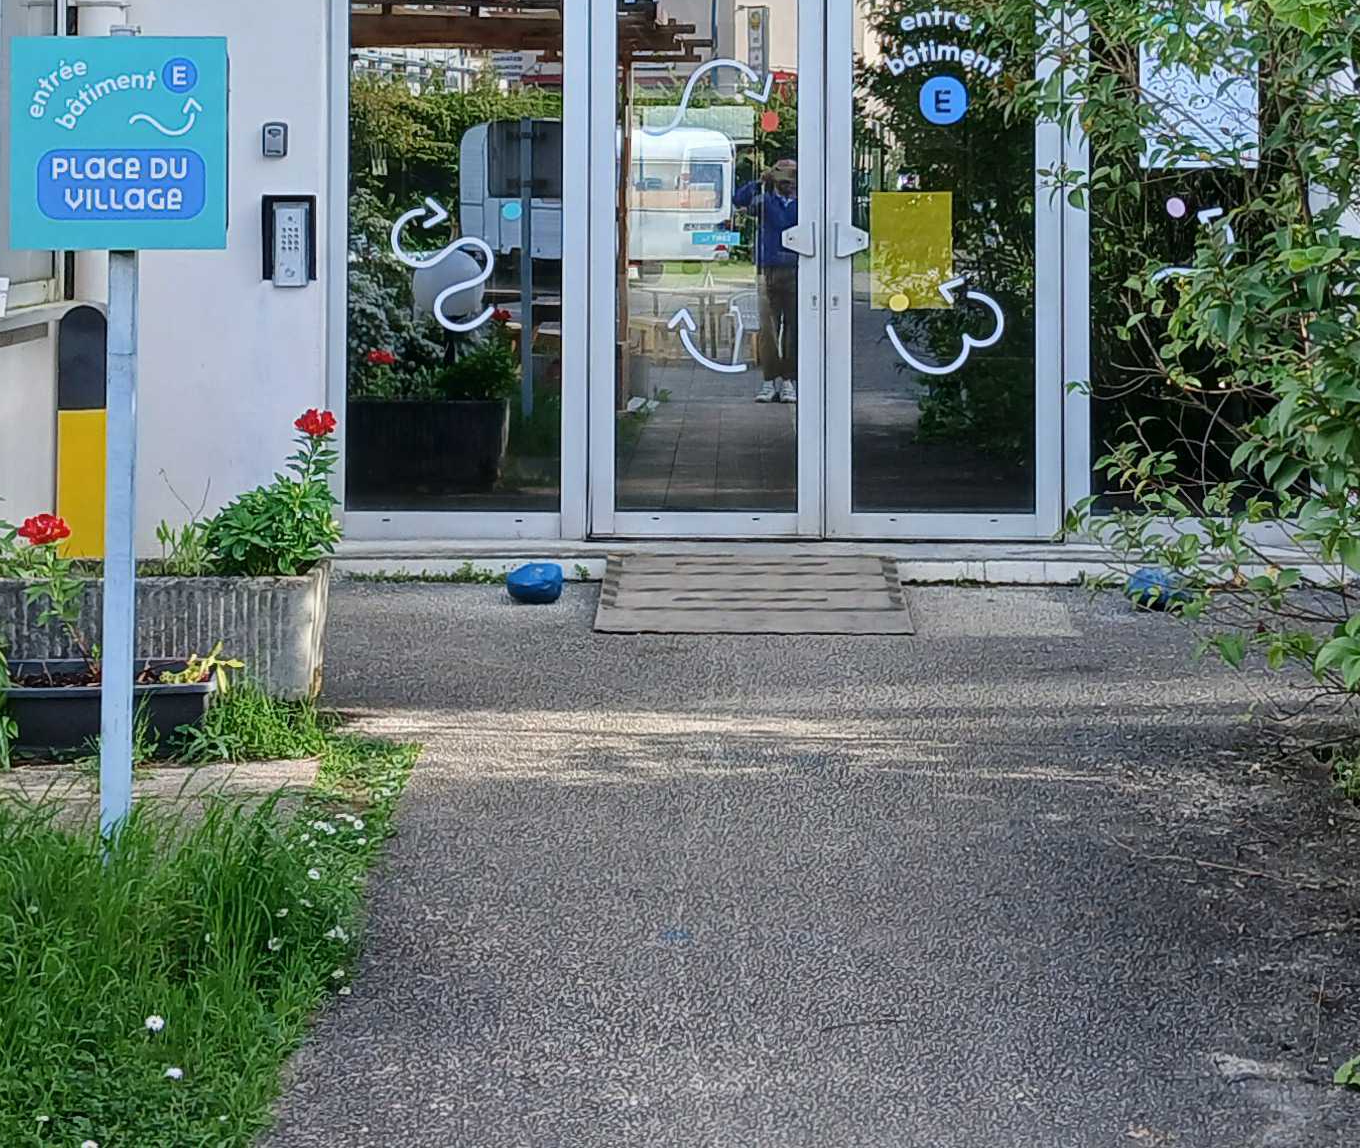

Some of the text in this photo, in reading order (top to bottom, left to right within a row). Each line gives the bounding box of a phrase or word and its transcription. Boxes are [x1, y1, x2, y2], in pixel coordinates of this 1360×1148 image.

[884, 39, 1004, 78] bâtiment
[29, 60, 87, 118] entrée
[55, 65, 187, 130] bâtiment E
[934, 89, 952, 114] E
[51, 157, 188, 180] PLACE DU
[64, 187, 182, 211] VILLAGE
